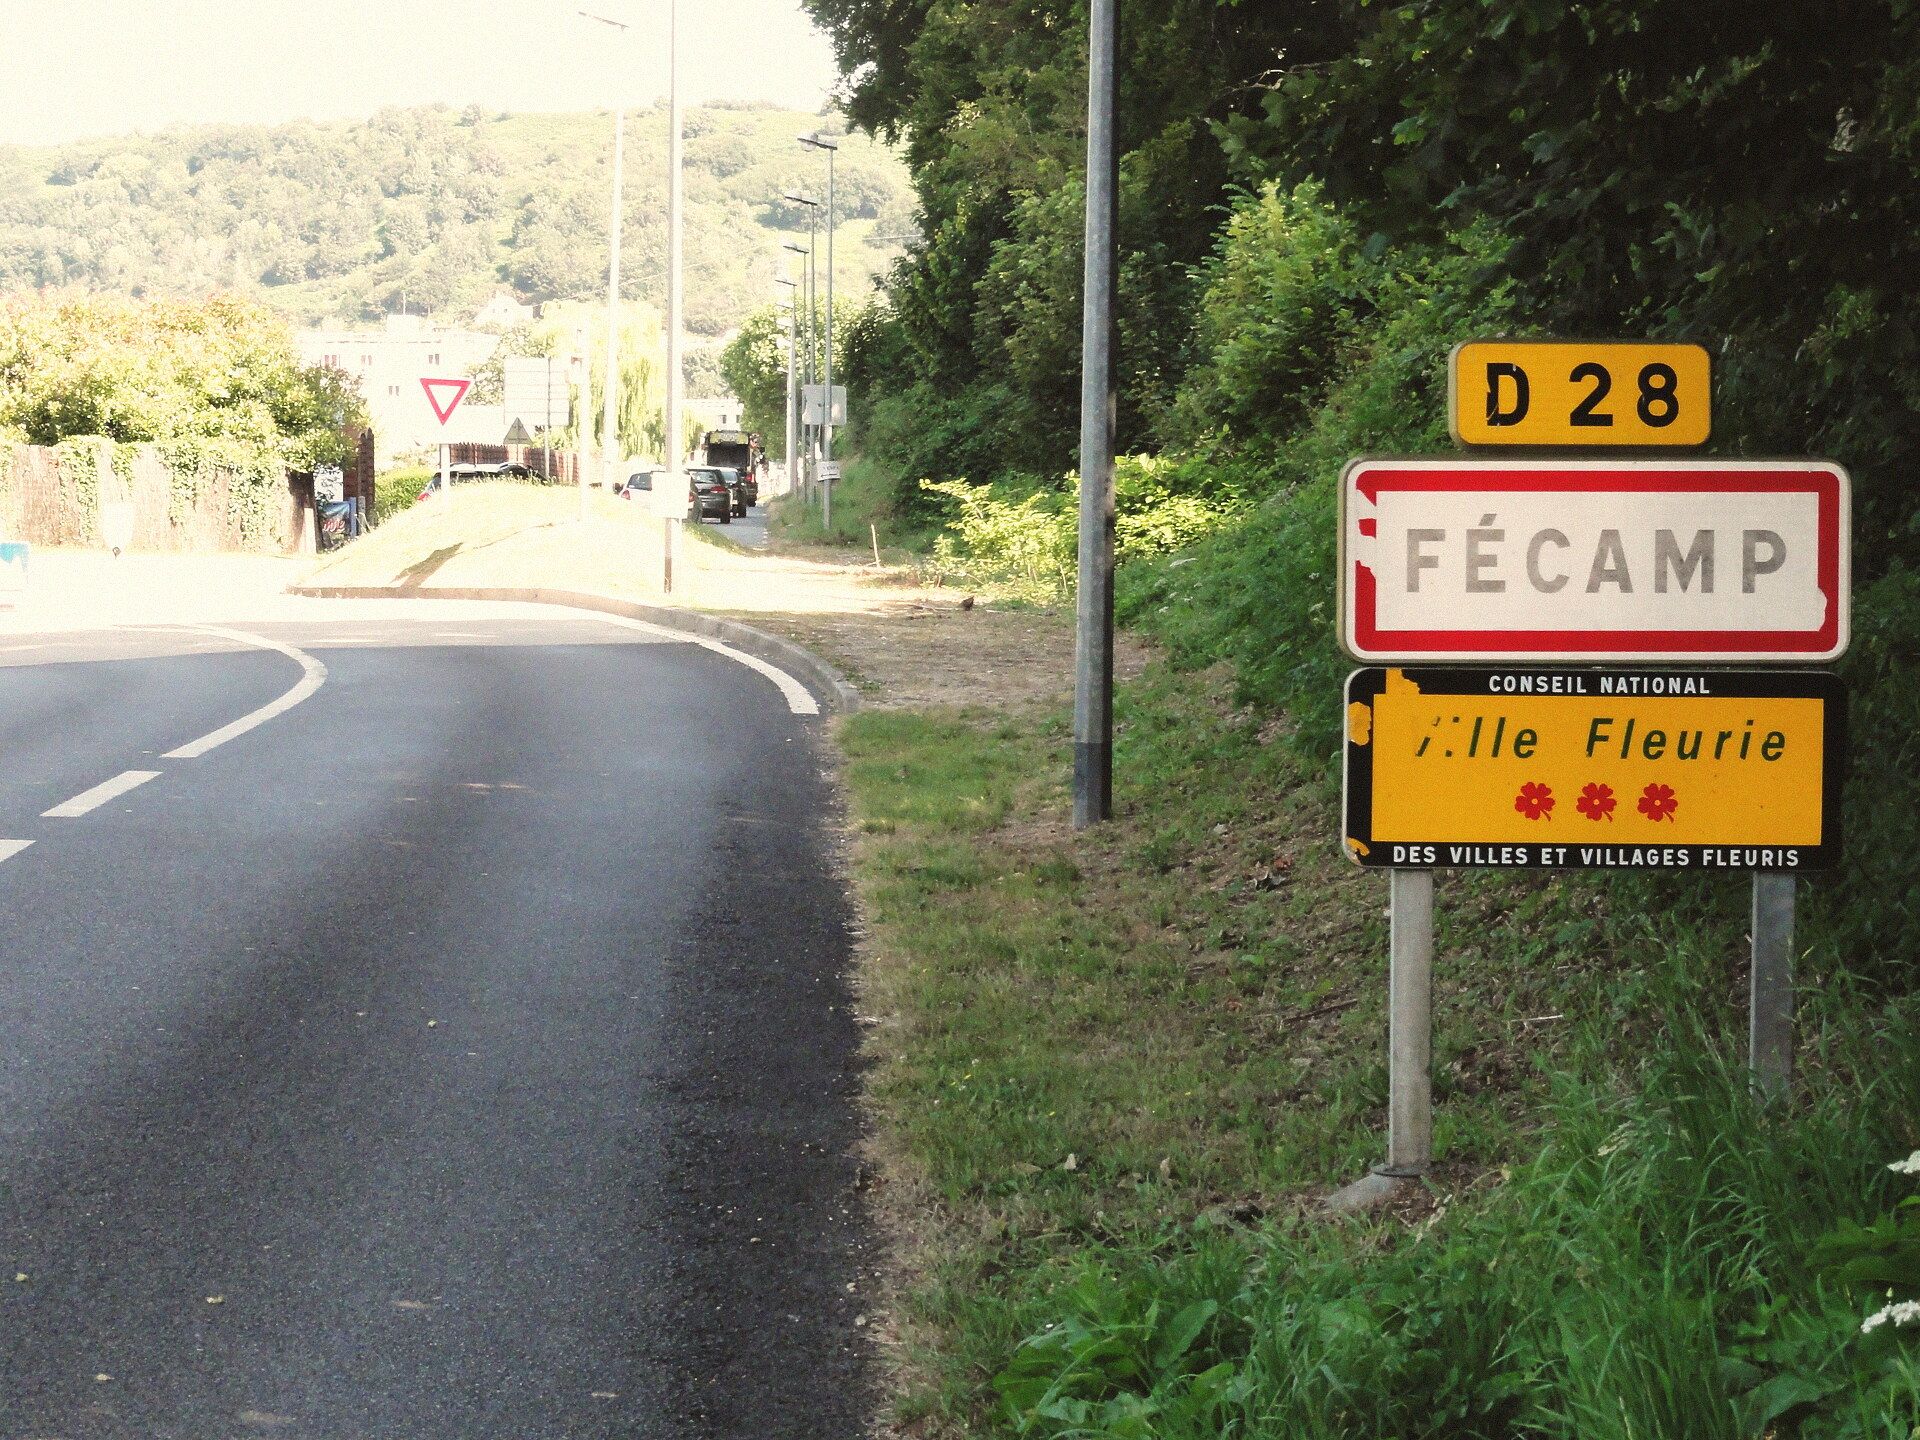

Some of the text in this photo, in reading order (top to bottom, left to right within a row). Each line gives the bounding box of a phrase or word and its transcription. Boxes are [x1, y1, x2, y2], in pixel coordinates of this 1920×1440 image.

[1485, 362, 1680, 428] D 28
[1405, 513, 1788, 594] FÉCAMP
[1489, 675, 1711, 695] CONSEIL NATIONAL
[1415, 716, 1787, 761] lle Fleurie
[1393, 845, 1800, 867] DES VILLES ET VILLAGES FLEURIS
